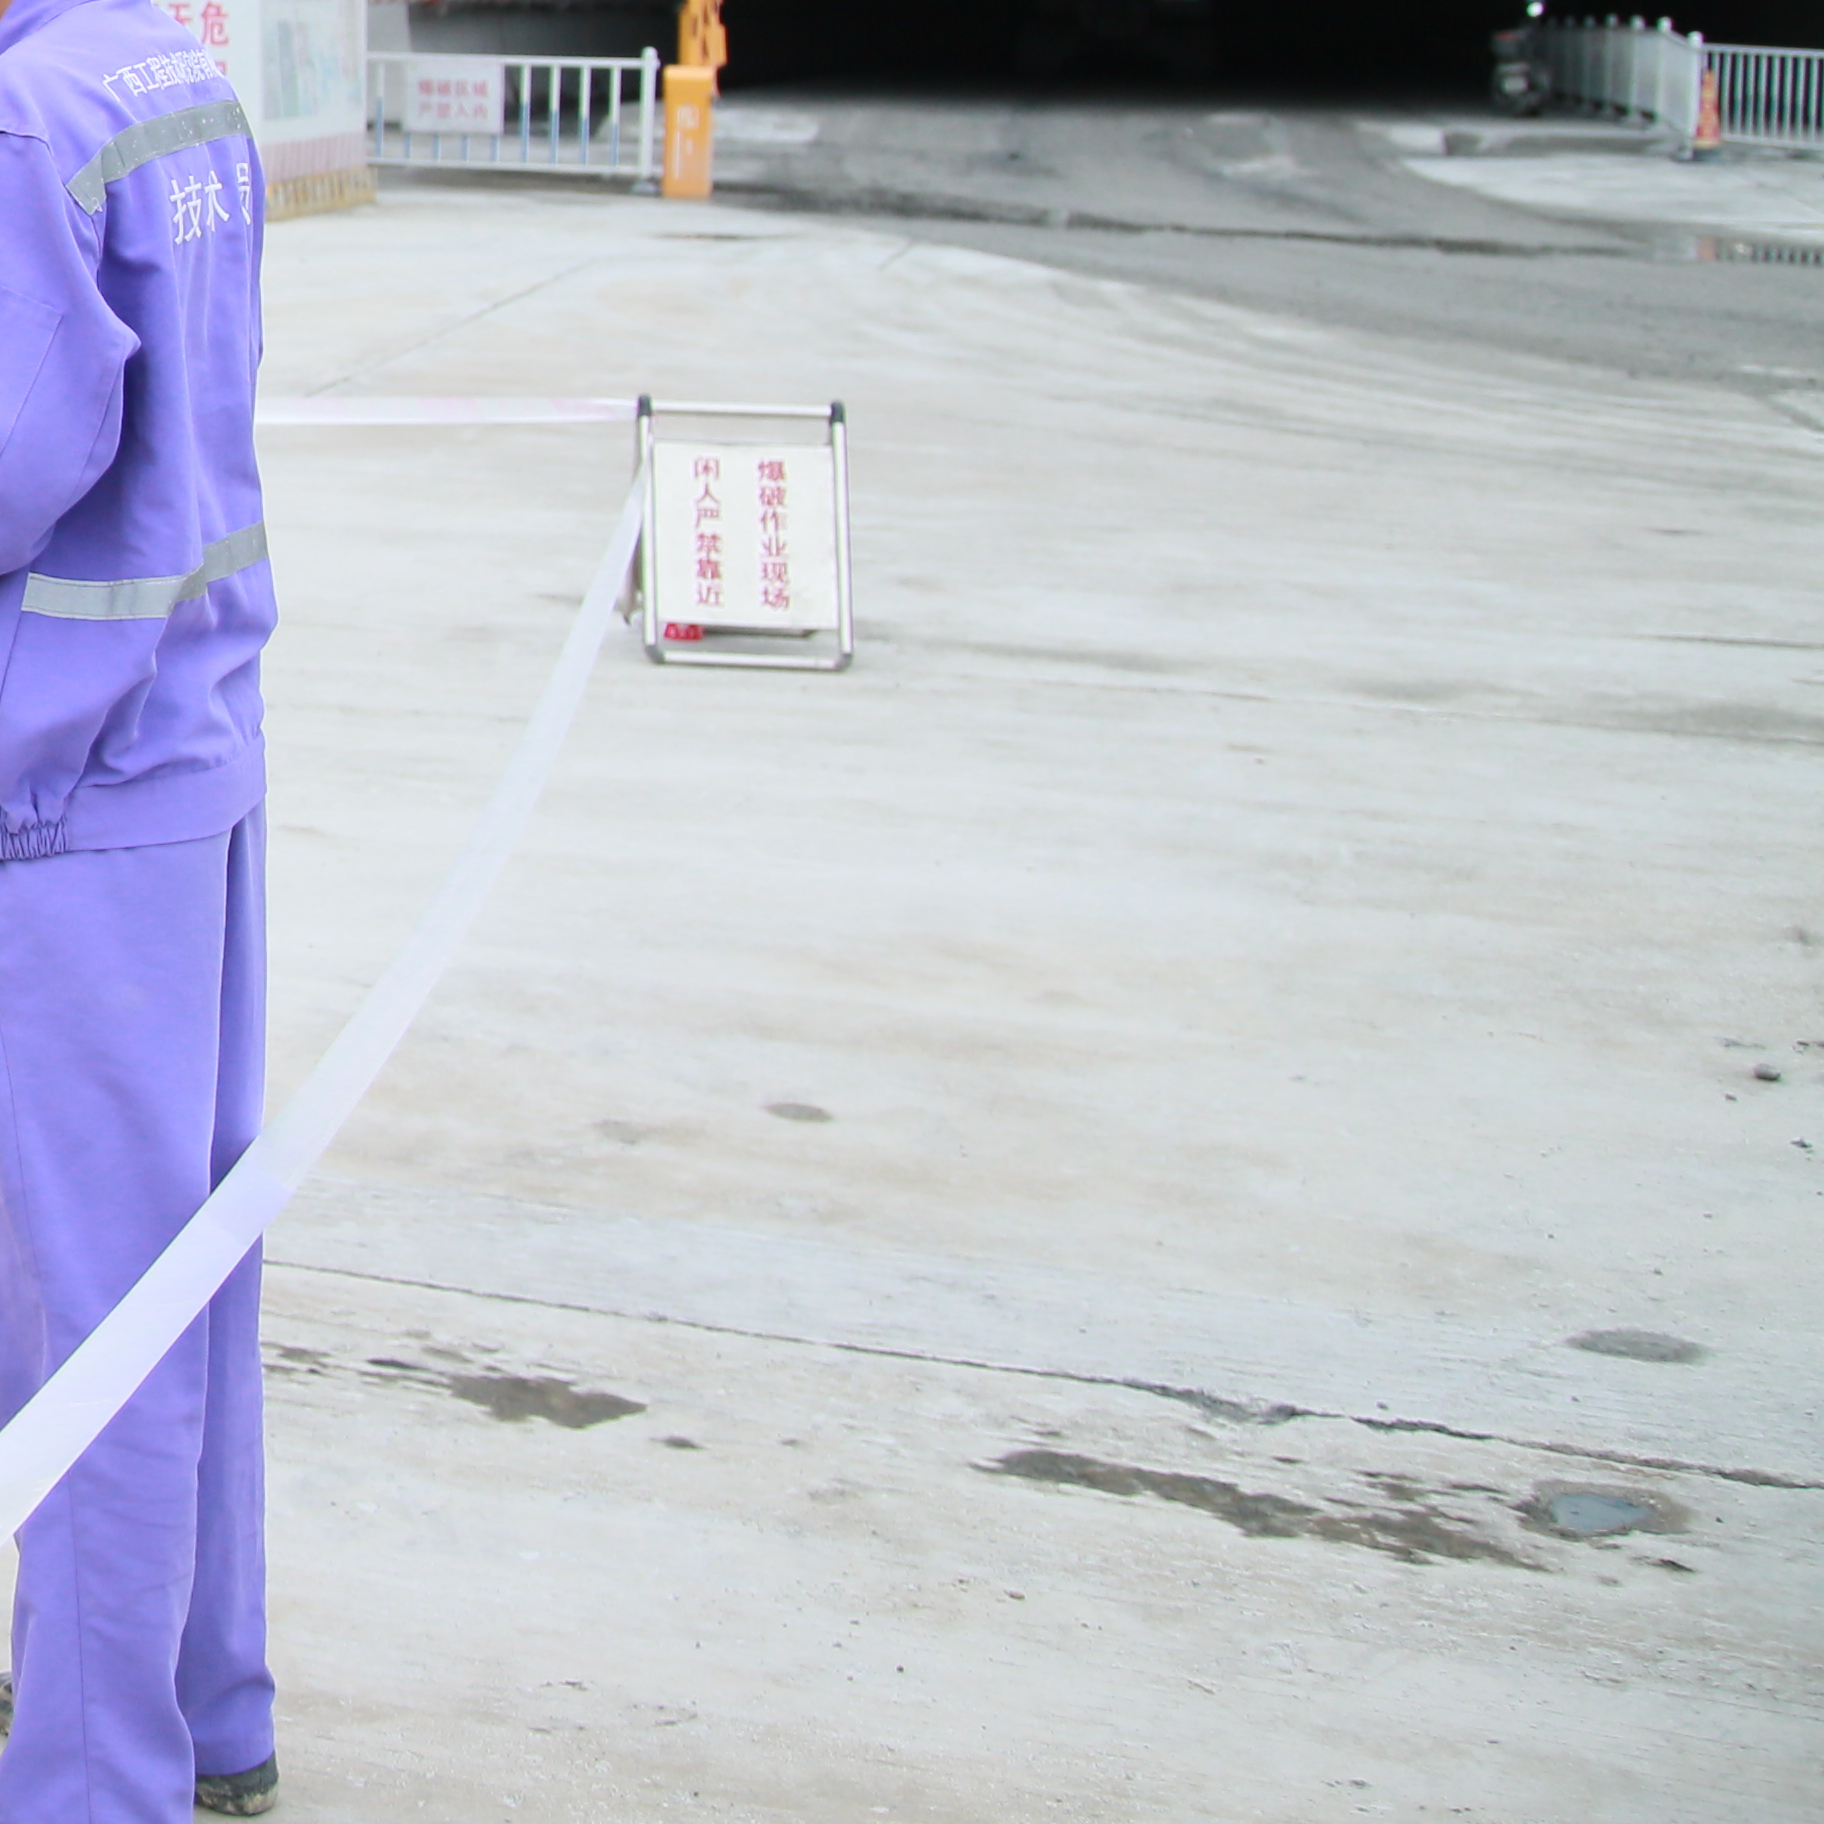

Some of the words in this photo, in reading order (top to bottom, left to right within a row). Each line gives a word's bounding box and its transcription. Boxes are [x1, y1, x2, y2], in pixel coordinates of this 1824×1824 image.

[694, 457, 723, 607] 闲人严禁靠近
[757, 460, 790, 611] 爆破作业现场
